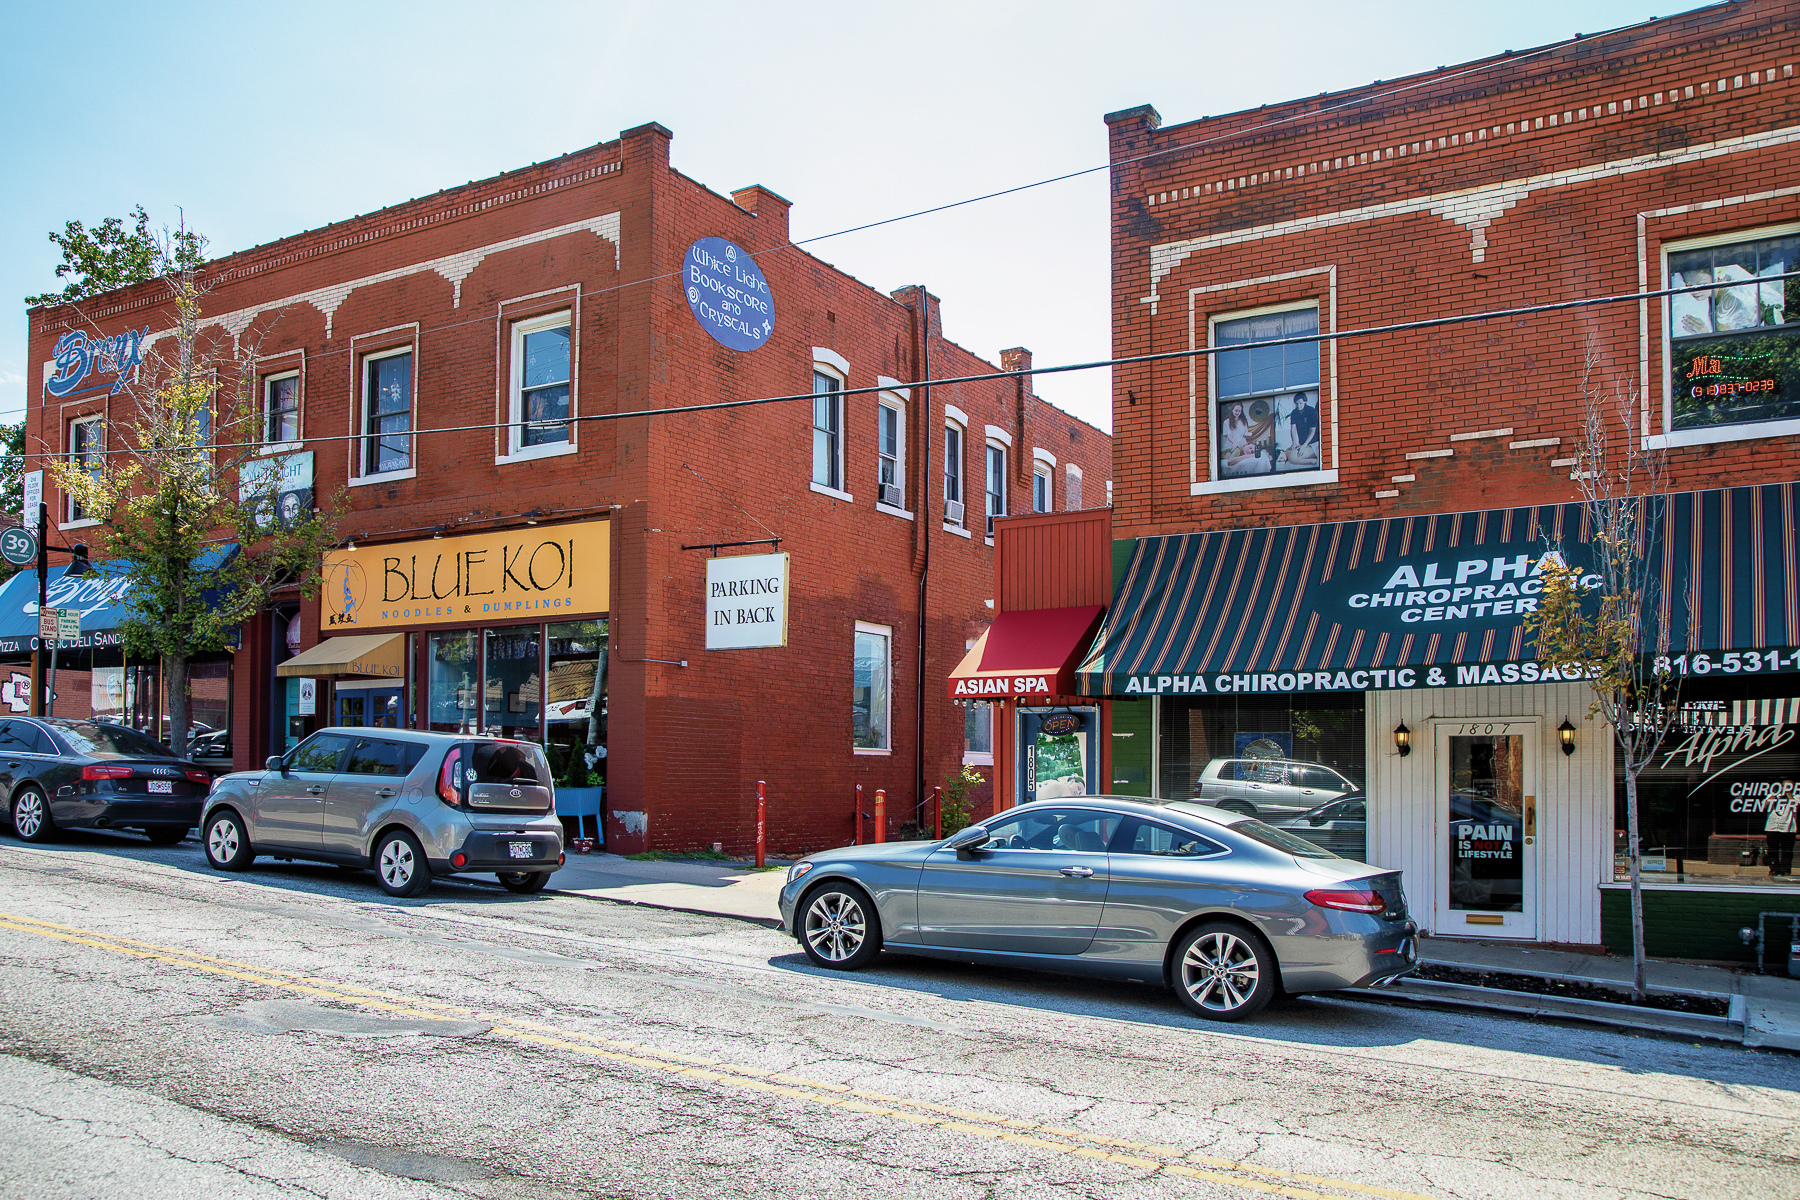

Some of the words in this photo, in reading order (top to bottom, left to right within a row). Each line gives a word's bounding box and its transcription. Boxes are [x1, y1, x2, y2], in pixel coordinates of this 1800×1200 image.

[721, 300, 742, 316] and
[5, 534, 30, 553] 39
[381, 548, 495, 603] BLUE
[501, 539, 574, 594] KOI
[1382, 550, 1568, 589] ALPHA
[711, 577, 779, 598] PARKING
[60, 609, 66, 617] 2
[381, 606, 453, 619] NOODLES
[463, 604, 471, 614] &
[483, 597, 573, 612] DUMPLINGS
[713, 609, 732, 626] IN
[736, 606, 776, 625] BACK
[1400, 598, 1538, 623] CENTER
[352, 661, 382, 675] BLUE
[382, 664, 400, 676] KOI
[954, 678, 1009, 695] ASIAN
[1013, 676, 1049, 693] SPA
[1124, 675, 1208, 693] ALPHA
[1214, 669, 1417, 693] CHIROPRACTIC
[1425, 667, 1447, 686] &
[1044, 718, 1075, 732] OPEN
[1458, 723, 1511, 735] 1807
[1660, 716, 1790, 780] Alpha
[1027, 745, 1035, 791] 1805
[1730, 798, 1799, 814] CENTER
[1458, 824, 1513, 841] PAIN
[1458, 840, 1471, 850] IS
[1474, 840, 1500, 851] NOT
[1502, 840, 1512, 851] A
[1458, 850, 1513, 859] LIFESTYLE
